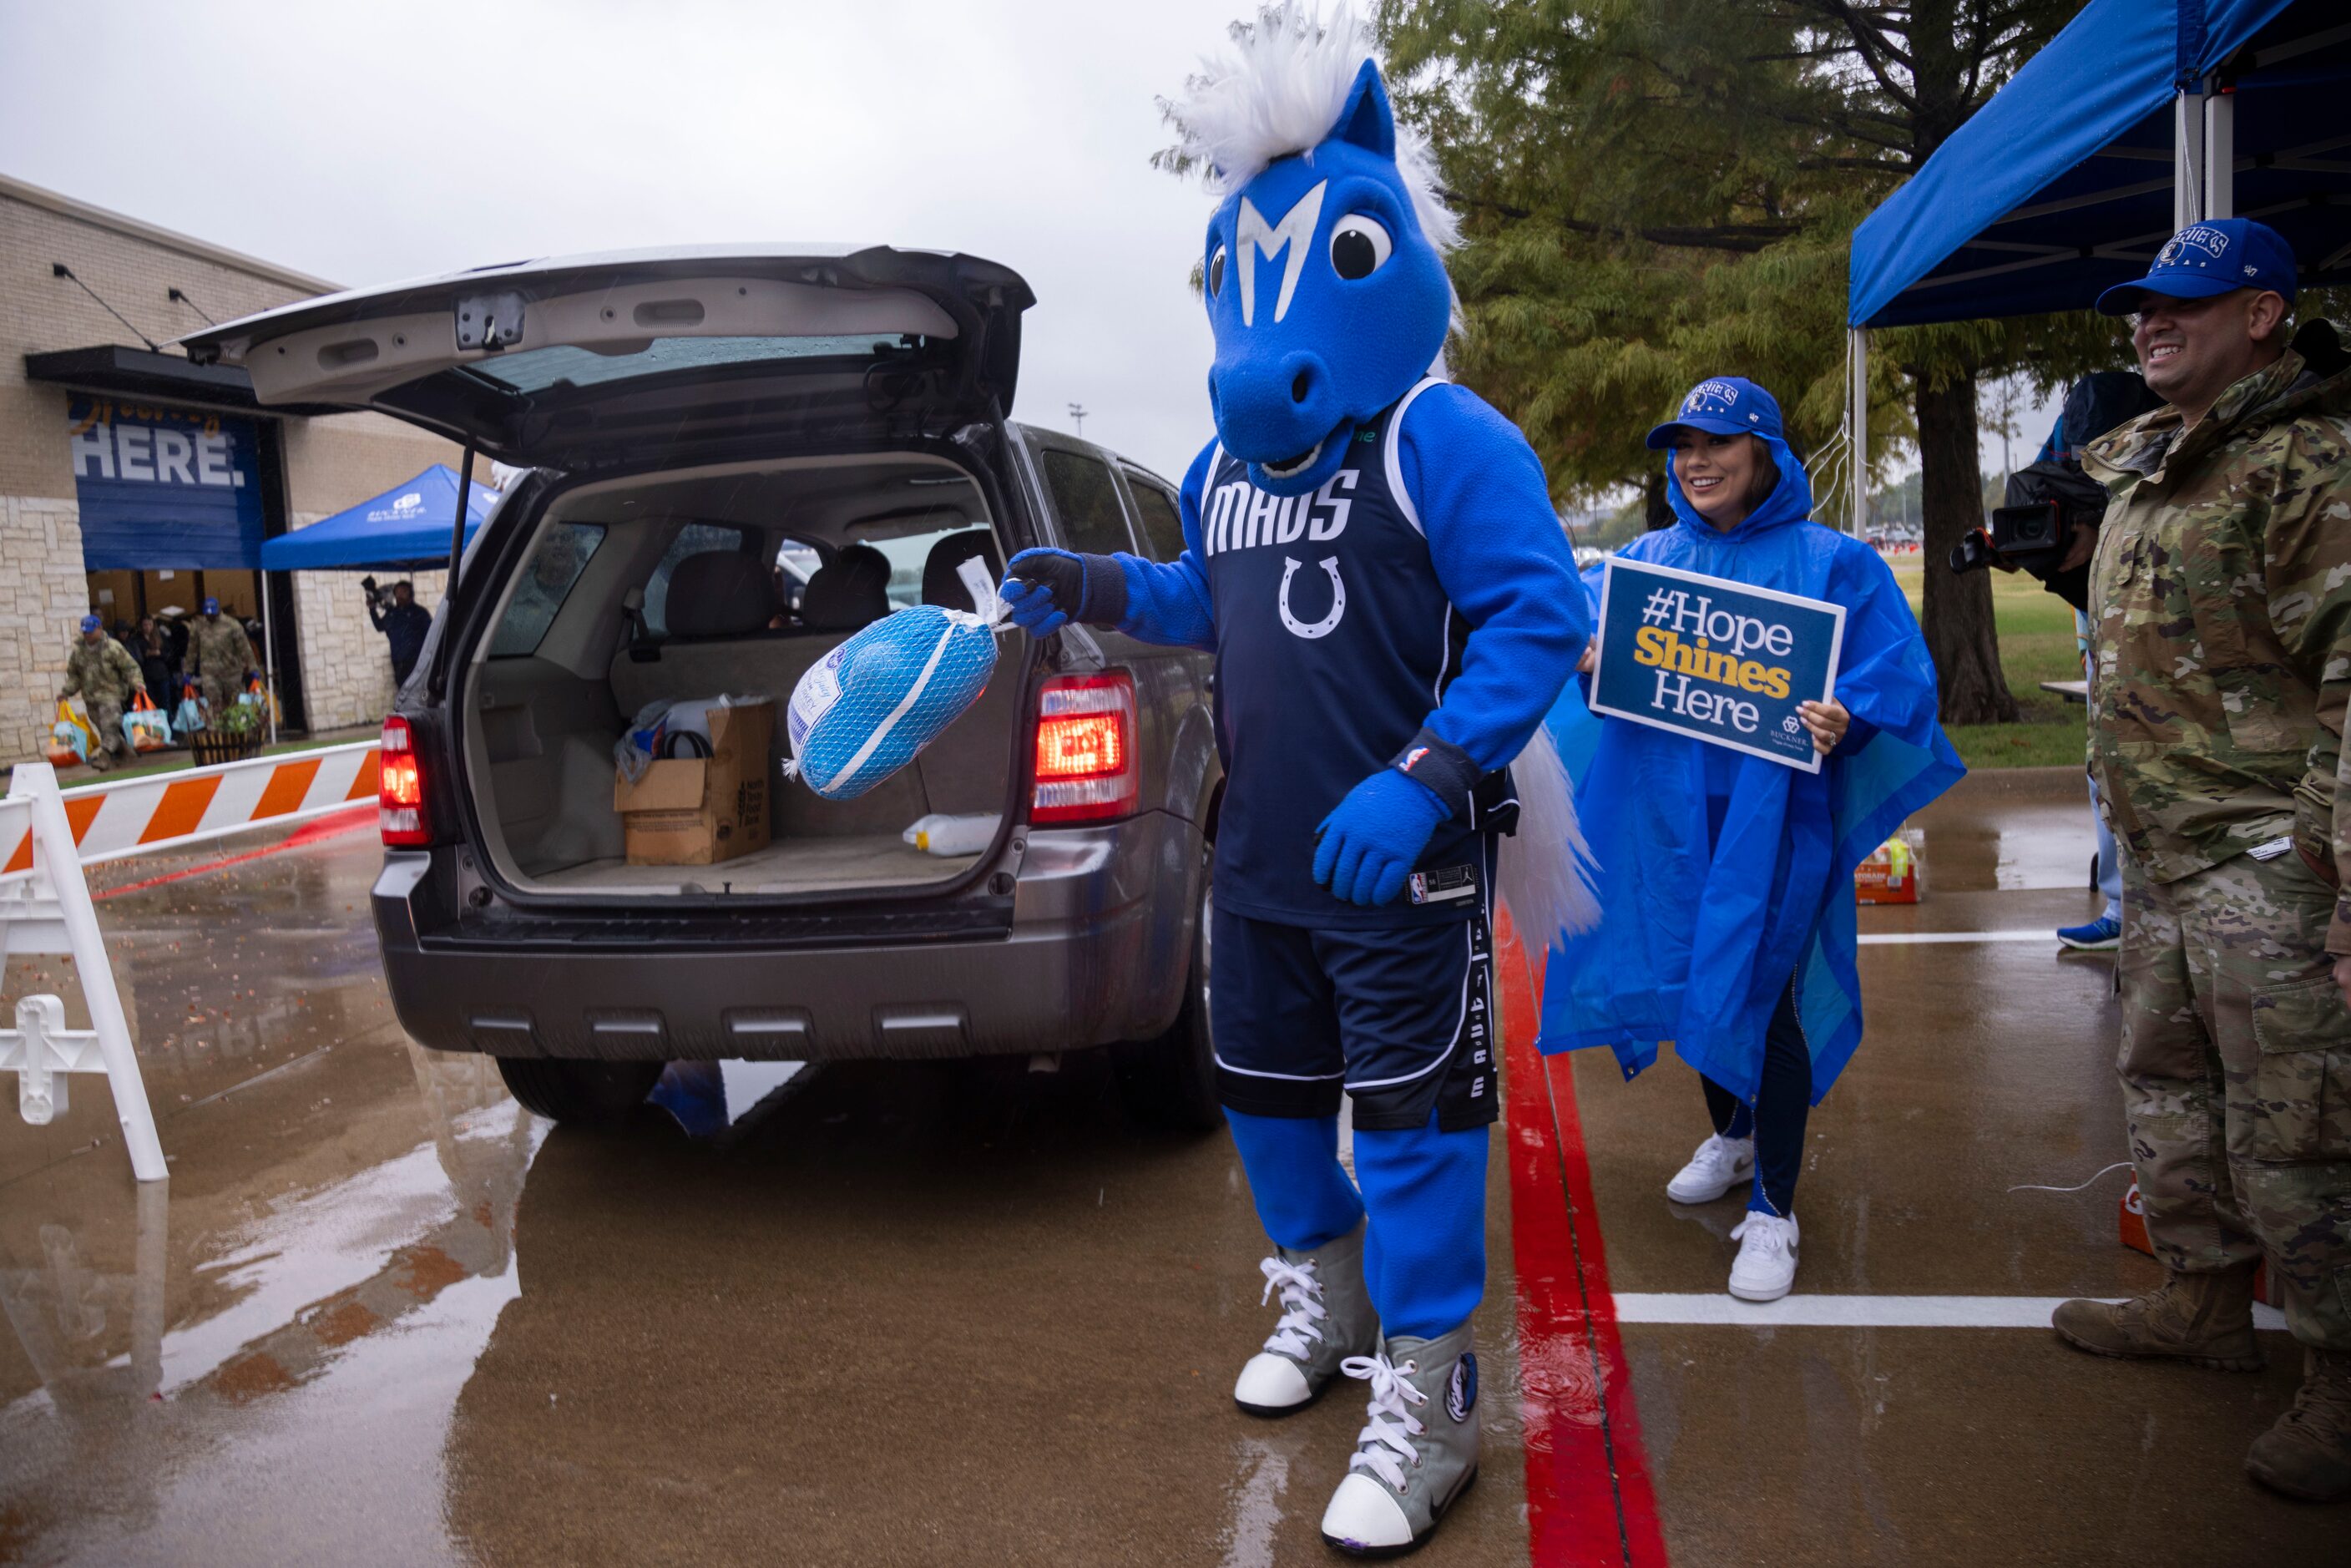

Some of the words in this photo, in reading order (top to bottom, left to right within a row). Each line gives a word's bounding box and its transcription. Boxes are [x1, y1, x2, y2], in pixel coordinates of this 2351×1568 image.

[1642, 587, 1793, 656] #Hope
[1634, 625, 1791, 700] Shines
[1651, 669, 1759, 733] Here
